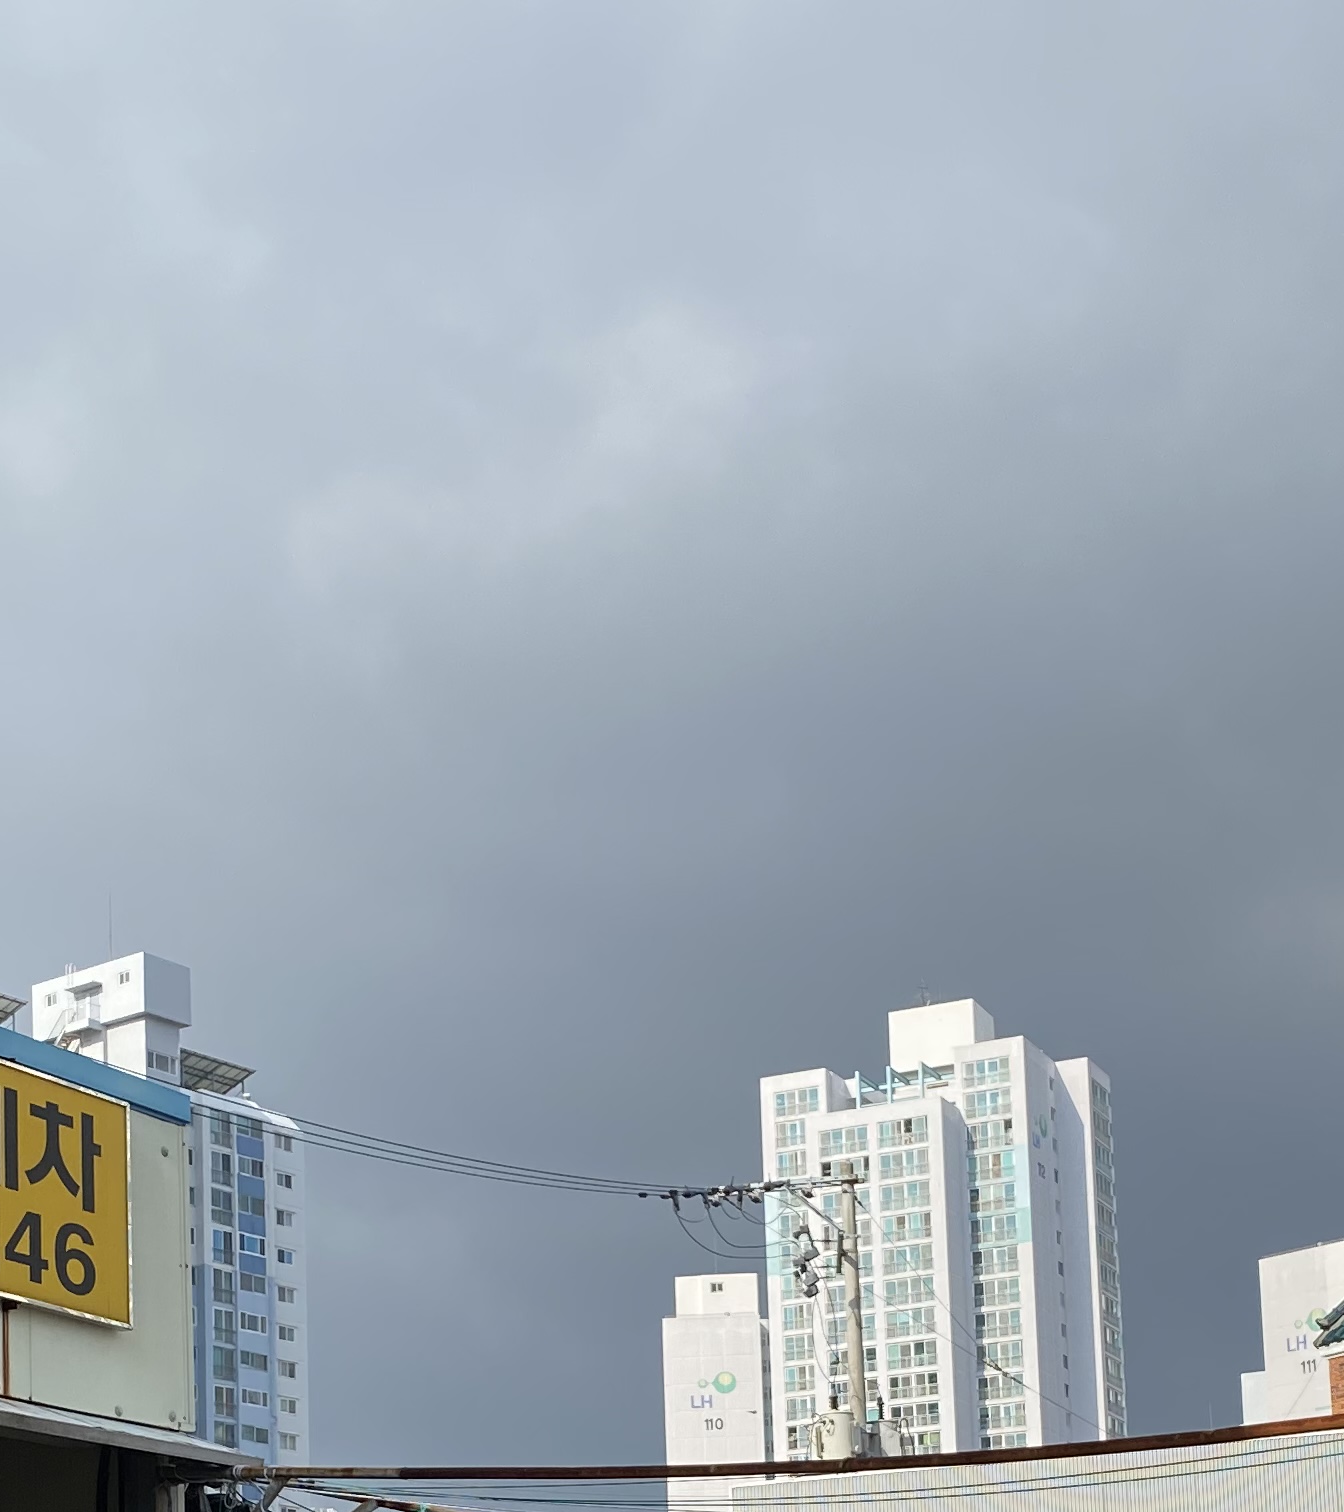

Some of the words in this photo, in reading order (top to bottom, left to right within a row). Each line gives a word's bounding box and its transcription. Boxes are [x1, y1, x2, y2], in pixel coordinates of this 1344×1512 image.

[1286, 1333, 1308, 1353] LH
[1300, 1359, 1317, 1374] 111
[690, 1394, 713, 1409] LH
[704, 1418, 724, 1431] 110
